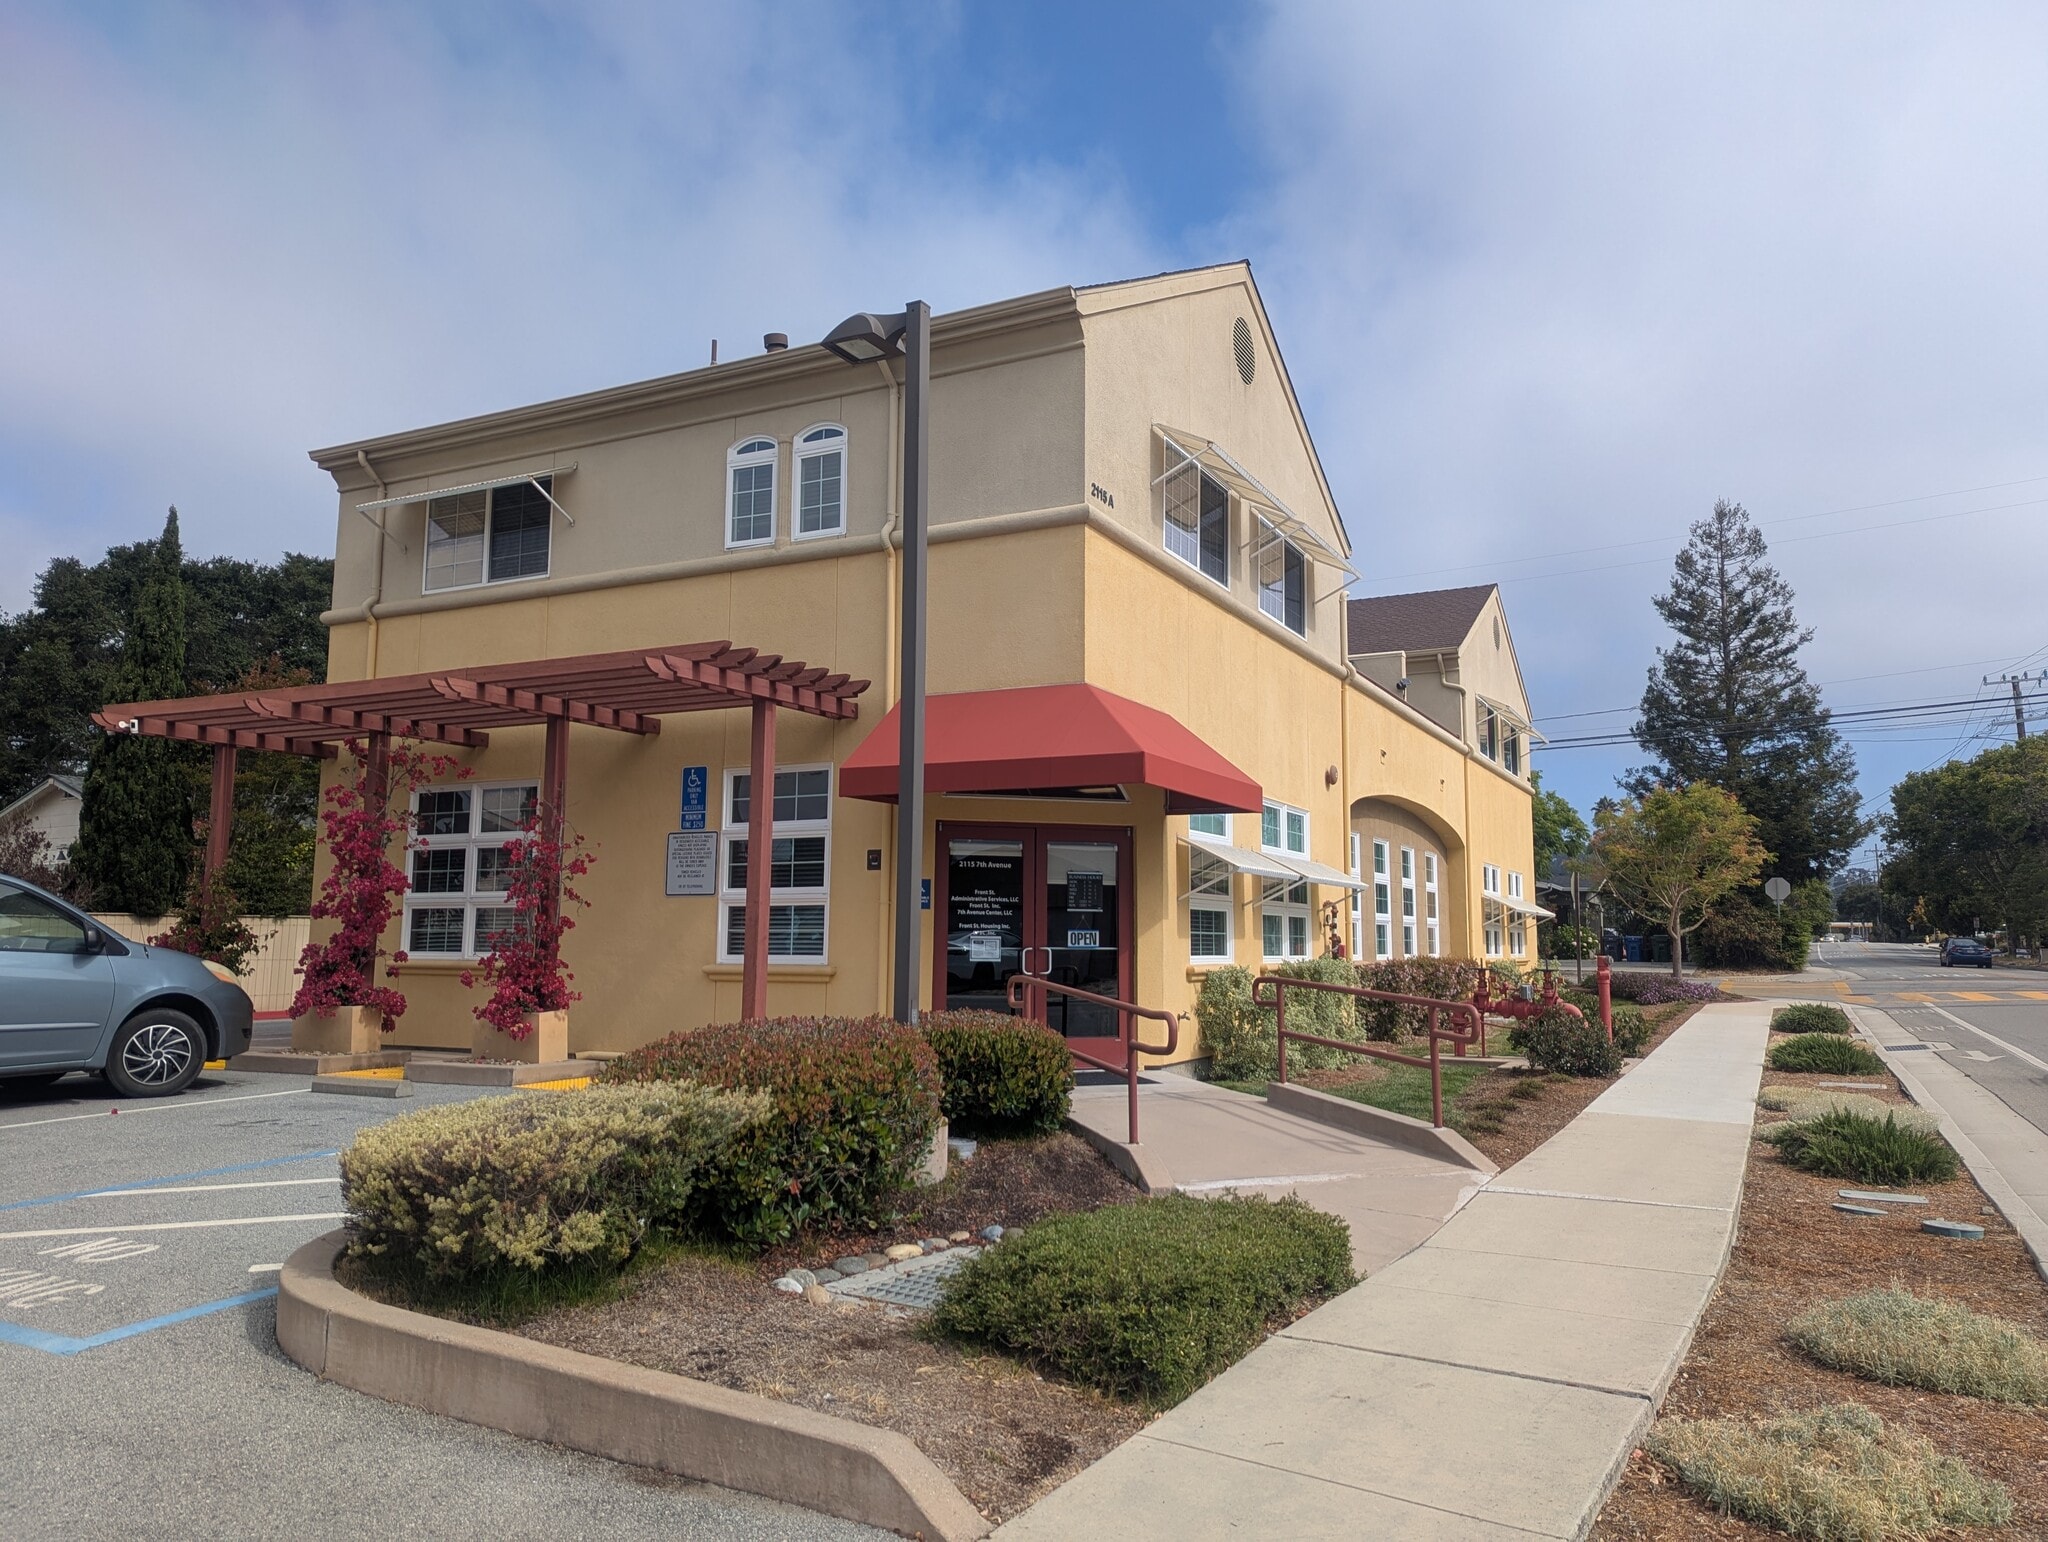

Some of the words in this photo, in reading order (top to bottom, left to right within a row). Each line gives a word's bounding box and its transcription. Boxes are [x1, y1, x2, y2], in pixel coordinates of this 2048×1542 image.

[1091, 482, 1107, 504] 2115
[1108, 494, 1114, 509] A
[1070, 932, 1097, 945] OPEN
[36, 1236, 161, 1264] NO
